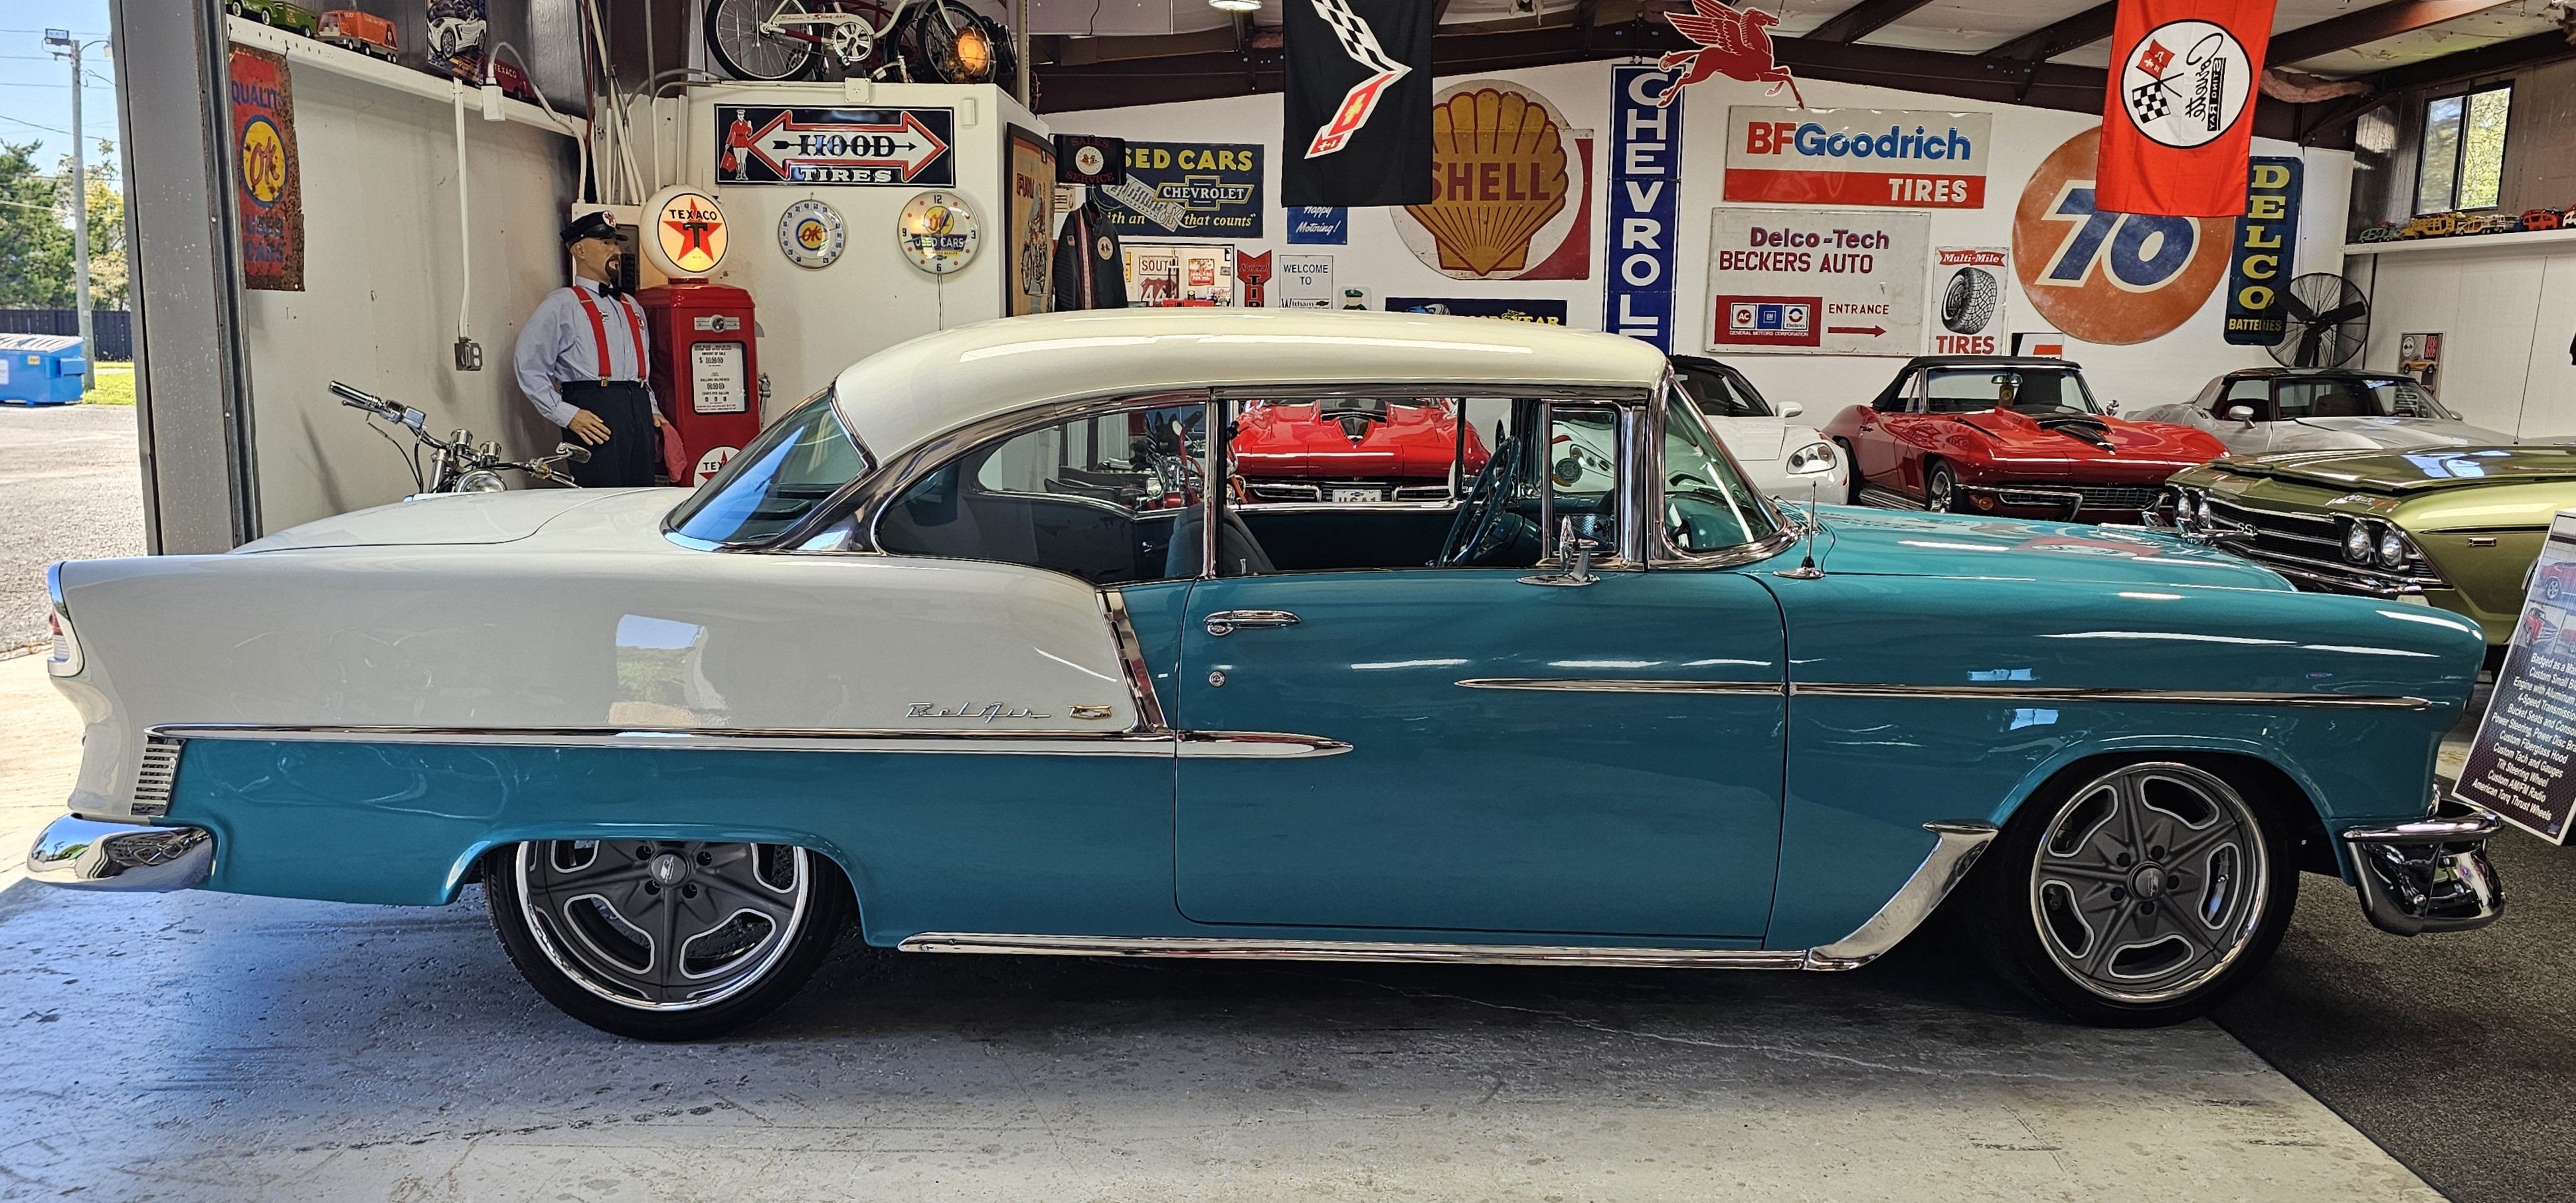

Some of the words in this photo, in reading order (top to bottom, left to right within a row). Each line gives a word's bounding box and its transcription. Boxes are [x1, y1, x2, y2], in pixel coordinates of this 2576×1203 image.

[494, 63, 517, 79] TEXACO
[232, 80, 282, 110] QUALIT
[798, 134, 897, 157] HOOD
[1071, 137, 1110, 149] SALES
[1747, 121, 1971, 161] BFGoodrich
[250, 136, 280, 186] OK
[1126, 147, 1171, 169] ED
[1178, 149, 1253, 171] CARS
[802, 169, 892, 183] TIRES
[1065, 170, 1114, 183] SERVICE
[1163, 187, 1245, 200] CHEVROLET
[1889, 178, 1968, 202] TIRES
[934, 195, 942, 204] 12
[1619, 72, 1669, 337] CHEVROL
[669, 209, 717, 220] TEXACO
[1107, 212, 1125, 224] ith
[1129, 214, 1145, 224] an
[1184, 212, 1211, 226] that
[683, 222, 708, 248] T
[902, 228, 907, 237] 9
[971, 230, 976, 239] 3
[1296, 220, 1341, 236] Motoring!
[940, 238, 964, 248] CARS
[1750, 226, 1890, 250] Delco-Tech
[2239, 165, 2290, 310] DELCO
[1719, 250, 1812, 273] BECKERS
[1819, 253, 1874, 274] AUTO
[1942, 252, 2002, 265] Multi-Mile
[936, 263, 942, 272] 6
[1283, 264, 1328, 274] WELCOME
[1300, 276, 1312, 285] TO
[1281, 298, 1314, 308] Witham
[1828, 303, 1890, 315] ENTRANCE
[1737, 312, 1750, 321] AC
[2228, 318, 2282, 332] BATTERIES
[1936, 335, 1995, 355] TIRES
[2531, 653, 2554, 668] Badged
[2552, 661, 2561, 670] as
[2529, 667, 2551, 682] Custom
[2551, 673, 2570, 688] Small
[2513, 676, 2533, 690] Engine
[2533, 684, 2546, 695] with
[2545, 686, 2575, 705] Aluminum
[2518, 692, 2542, 708] 4-Speed
[2507, 703, 2528, 718] Bucket
[2526, 710, 2543, 724] Seats
[2543, 718, 2557, 729] and
[2491, 712, 2510, 727] Power
[2533, 727, 2553, 742] Power
[2551, 734, 2567, 748] Disc
[2565, 740, 2576, 753] Bra
[2499, 730, 2522, 746] Custom
[2520, 738, 2551, 758] Fiberglass
[2550, 749, 2569, 764] Hood
[2493, 742, 2515, 758] Custom
[2514, 750, 2529, 764] Tach
[2528, 758, 2541, 769] and
[2540, 760, 2564, 778] Gauges
[2496, 758, 2507, 771] Tilt
[2505, 762, 2530, 782] Steering
[2529, 771, 2549, 788] Wheel
[2487, 769, 2510, 786] Custom
[2528, 787, 2547, 803] Radio
[2471, 777, 2498, 797] American
[2498, 789, 2512, 805] Torq
[2511, 794, 2532, 811] Thrust
[2529, 803, 2553, 821] Wheels
